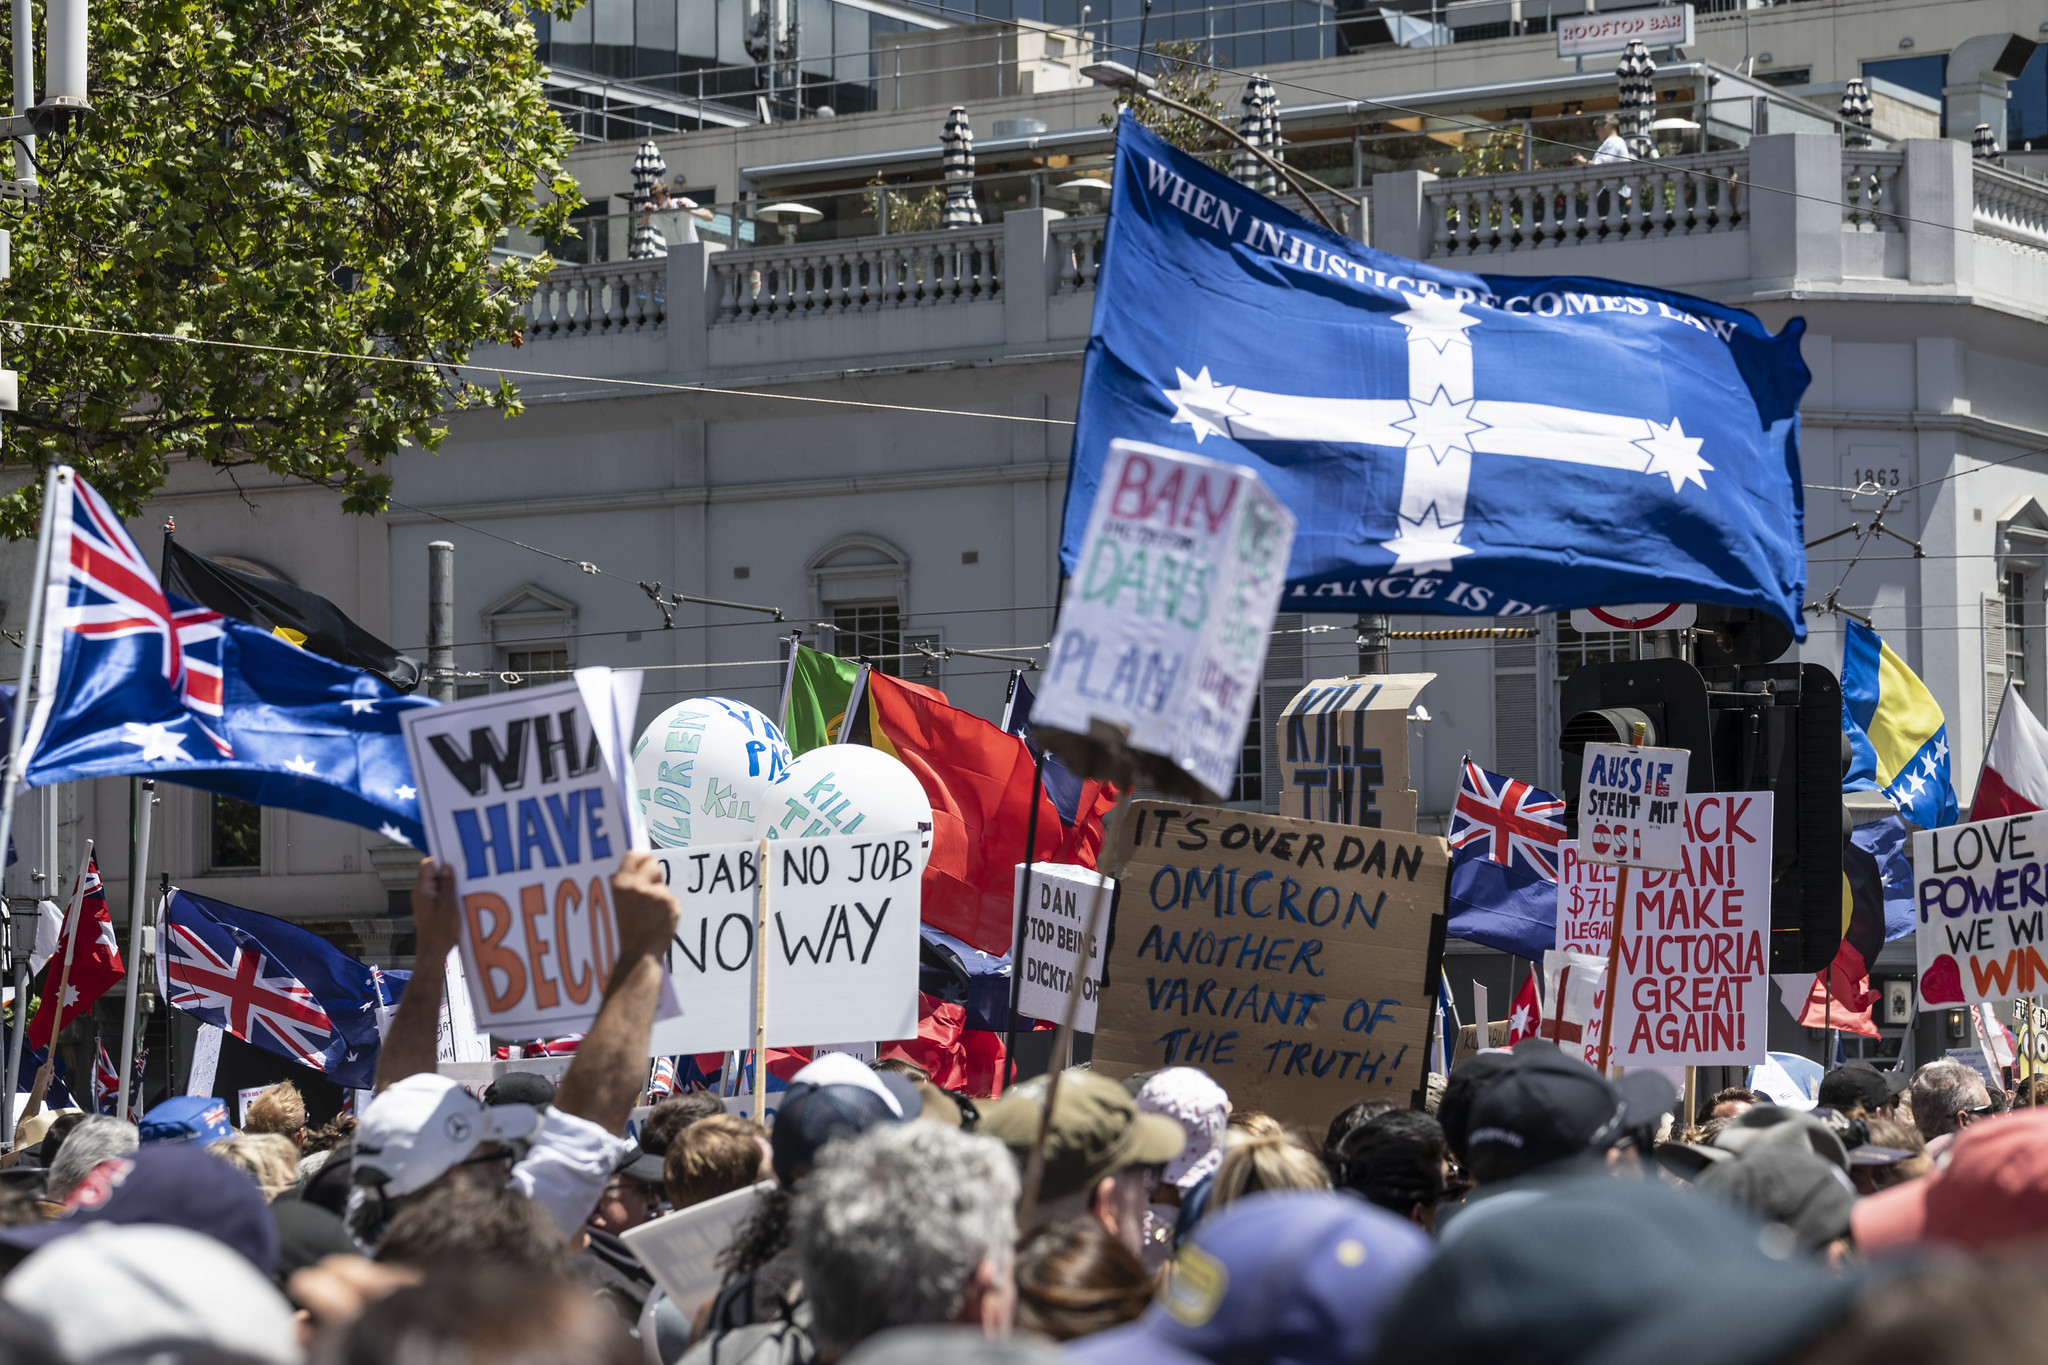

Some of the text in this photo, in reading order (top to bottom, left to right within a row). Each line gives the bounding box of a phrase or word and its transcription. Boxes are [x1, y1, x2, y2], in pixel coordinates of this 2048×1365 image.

[1563, 14, 1681, 41] ROOFTOP BAR
[1148, 157, 1242, 236] WHEN
[1110, 454, 1242, 534] BAN
[1854, 468, 1900, 487] 1863
[1444, 581, 1495, 612] IS
[1052, 628, 1184, 716] PLAN
[1286, 683, 1384, 767] KILL
[1293, 763, 1385, 831] THE
[1587, 754, 1674, 797] AUSSIE
[1587, 788, 1679, 825] STEHT MIT
[1682, 796, 1757, 845] ACK
[453, 787, 612, 881] HAVE
[1134, 809, 1424, 882] IT'S OVER DAN
[1932, 815, 2034, 874] LOVE
[687, 850, 758, 893] JAB
[783, 845, 829, 886] NO
[848, 840, 912, 882] JOB
[1919, 862, 2048, 923] POWER
[1041, 883, 1082, 923] DAN,
[1149, 862, 1388, 931] OMICRON
[1636, 888, 1745, 931] MAKE
[463, 873, 622, 1014] BECO
[666, 897, 893, 974] NO WAY
[1023, 914, 1055, 945] STOP
[1136, 924, 1325, 977] ANOTHER
[1620, 930, 1765, 976] VICTORIA
[1945, 918, 1995, 955] WE
[1027, 957, 1101, 1003] DICKTAOR
[1146, 973, 1403, 1034] VARIANT OF
[1632, 975, 1753, 1014] GREAT
[1153, 1026, 1409, 1087] THE TRUTH!
[1628, 1012, 1746, 1054] AGAIN!
